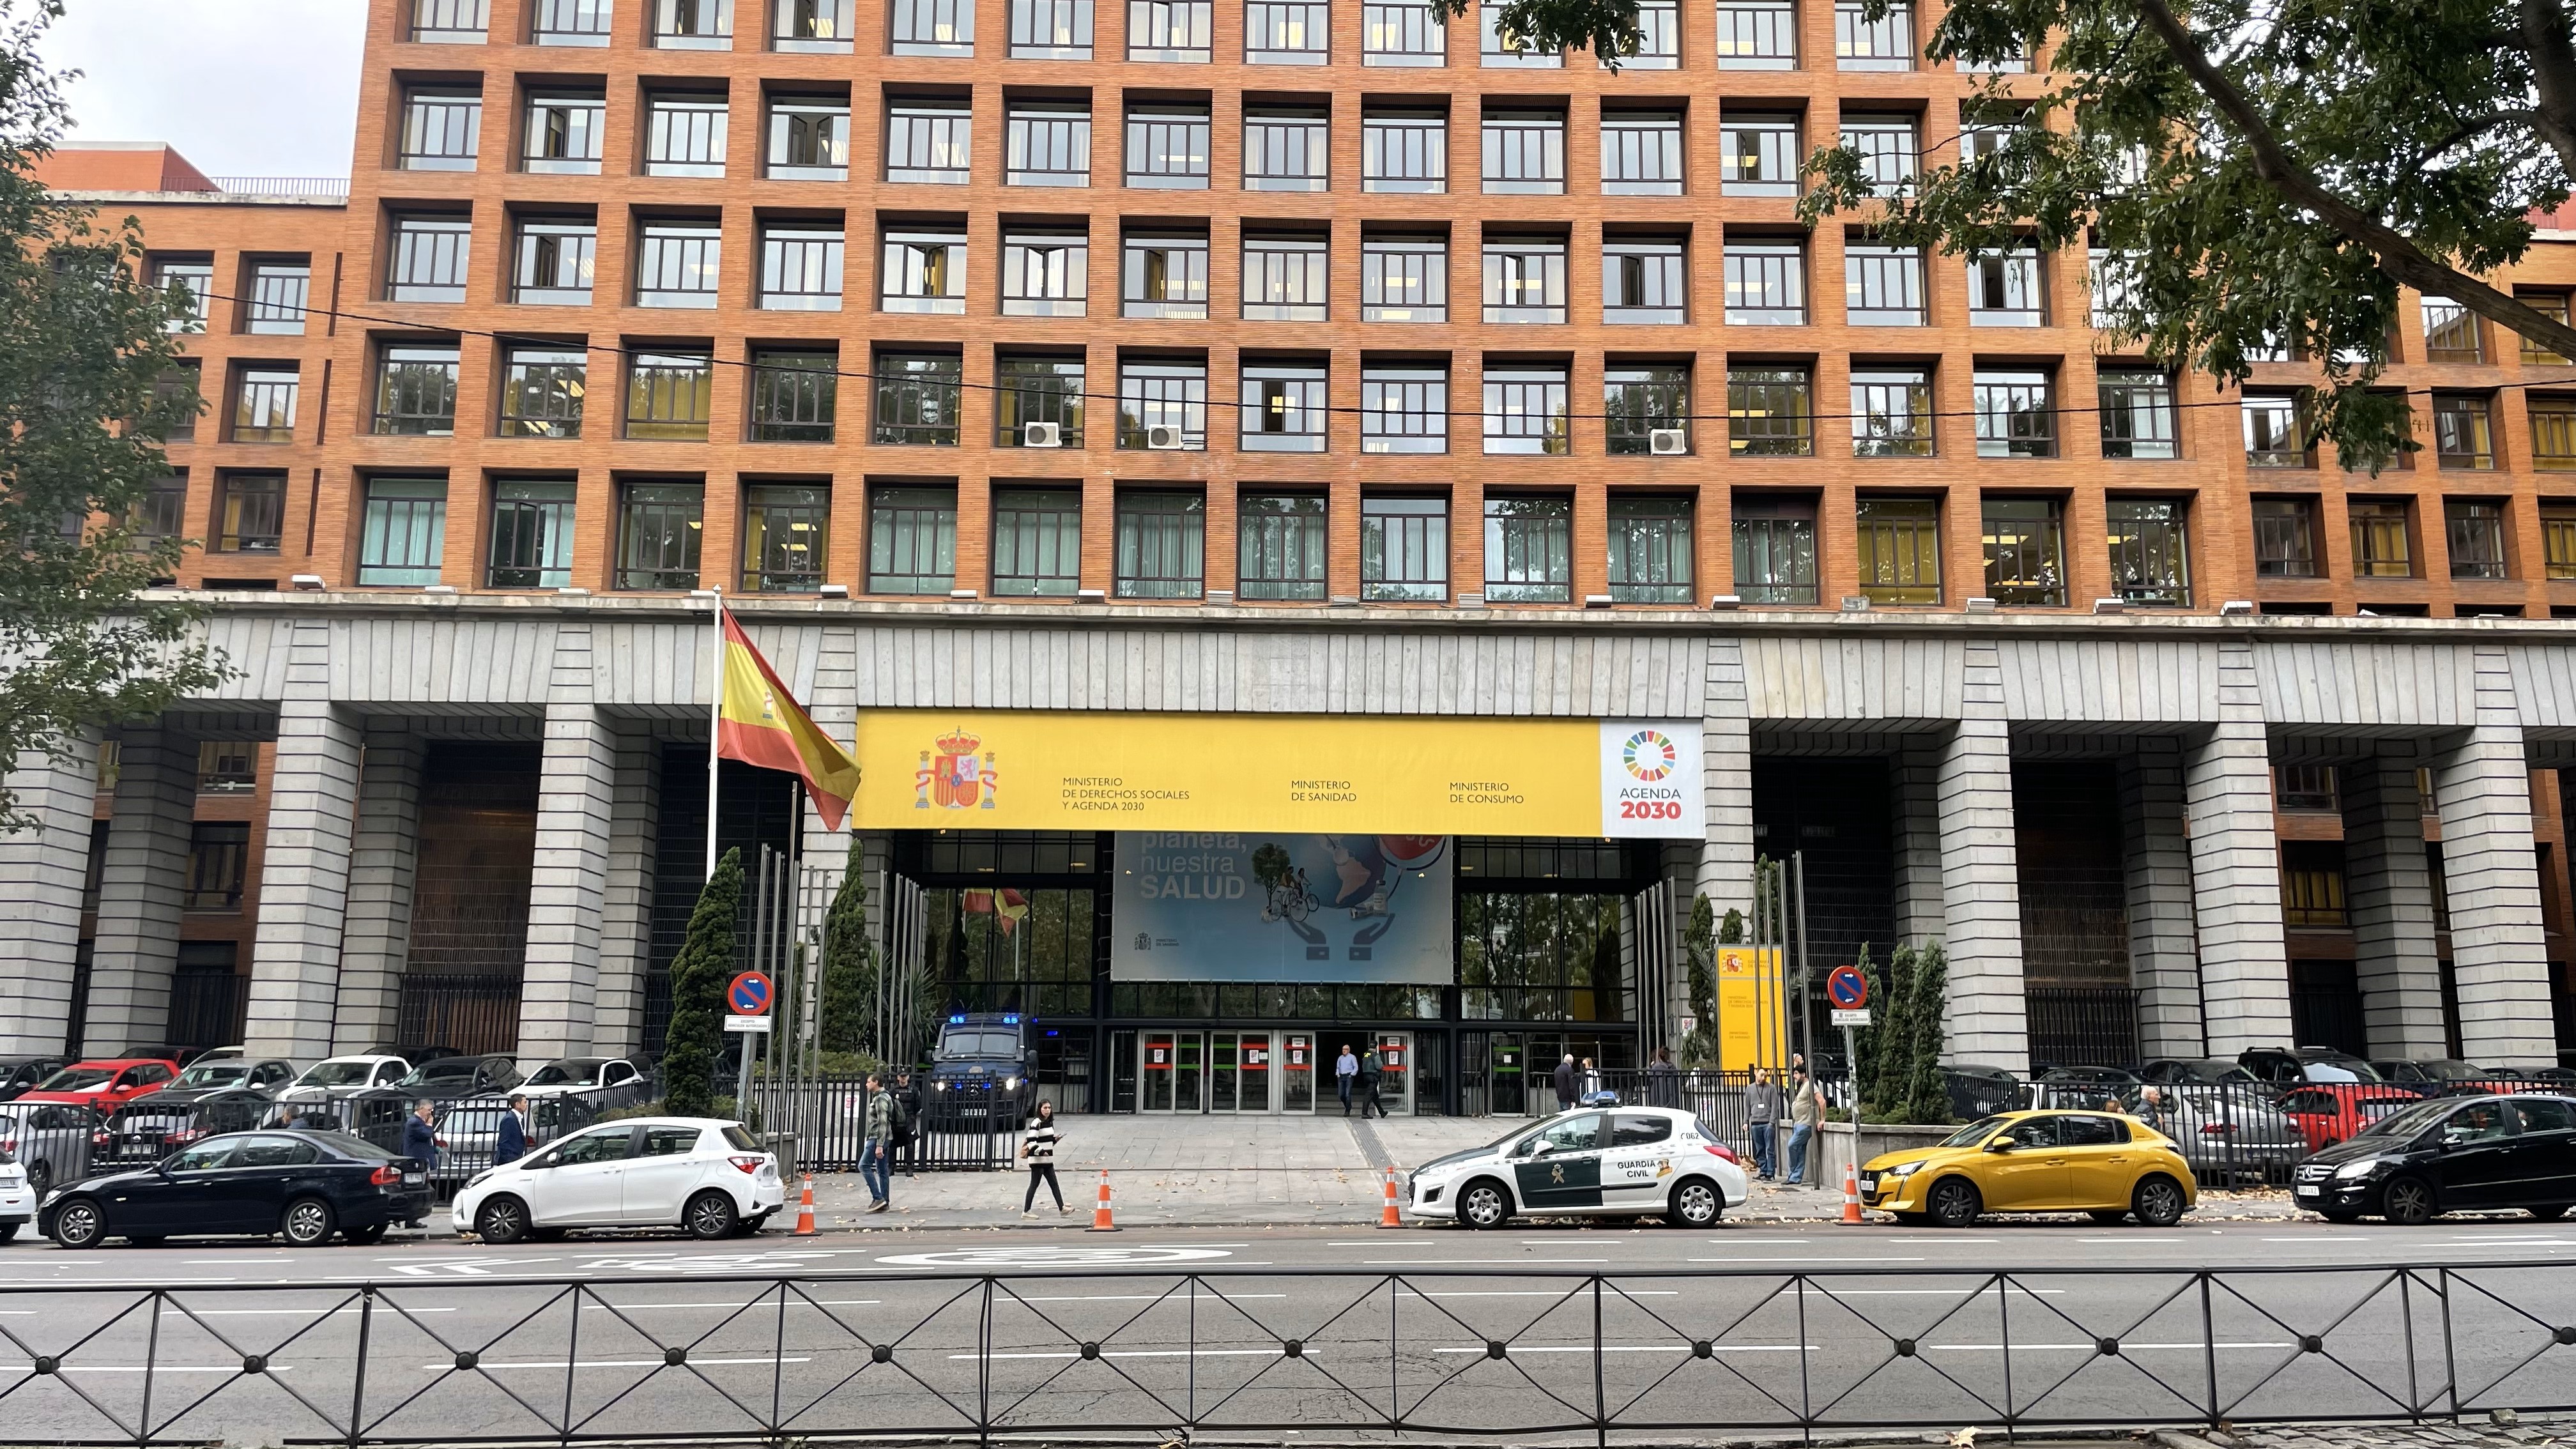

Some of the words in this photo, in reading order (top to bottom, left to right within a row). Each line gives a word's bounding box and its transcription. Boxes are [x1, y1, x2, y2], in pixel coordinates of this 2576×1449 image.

[1063, 777, 1123, 786] MINISTERIO
[1291, 780, 1351, 790] MINISTERIO
[1450, 782, 1509, 792] MINISTERIO
[1062, 789, 1077, 798] DE
[1080, 790, 1137, 799] DERECHOS
[1140, 790, 1190, 799] SOCIALES
[1291, 792, 1305, 801] DE
[1308, 793, 1357, 802] SANIDAD
[1620, 788, 1682, 799] AGENDA
[1450, 794, 1464, 803] DE
[1467, 794, 1524, 804] CONSUMO
[1062, 801, 1070, 810] Y
[1071, 802, 1118, 810] AGENDA
[1121, 802, 1144, 811] 2030
[1620, 801, 1682, 820] 2030
[1140, 852, 1235, 873] nuestra
[1140, 874, 1246, 900] SALUD
[1617, 1160, 1656, 1169] GUARDIA
